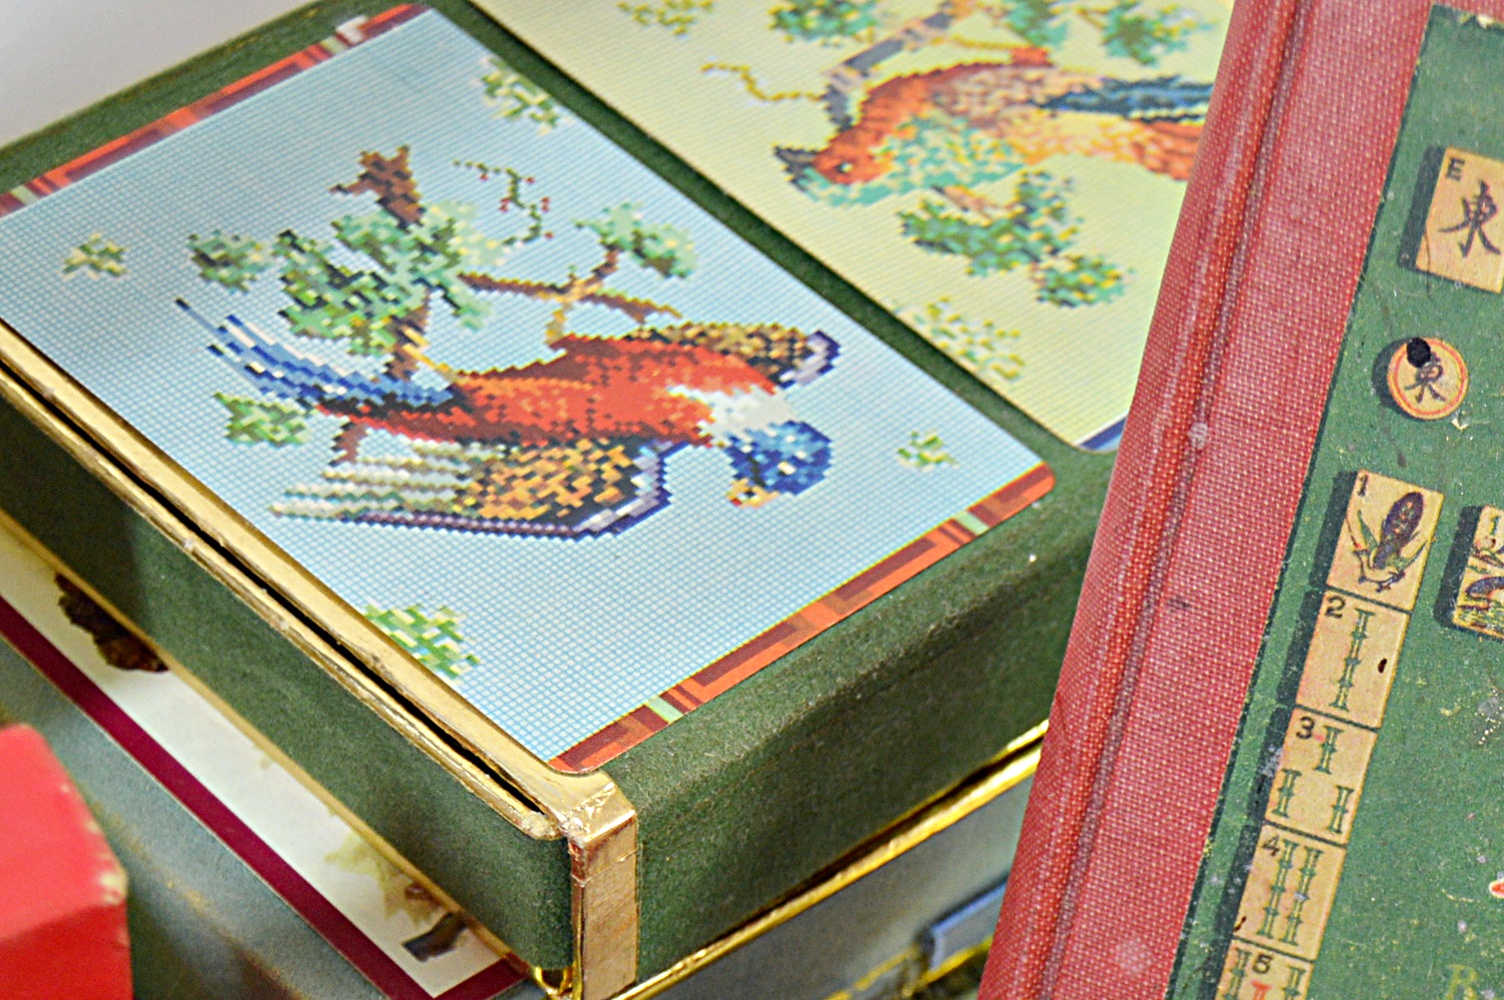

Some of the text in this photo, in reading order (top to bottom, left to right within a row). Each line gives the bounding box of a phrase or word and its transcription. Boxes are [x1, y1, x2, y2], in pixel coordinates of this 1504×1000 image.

[1445, 158, 1466, 181] E
[1439, 179, 1502, 259] 東
[1357, 475, 1368, 497] 1
[1325, 596, 1347, 619] 2
[1296, 716, 1315, 740] 3
[1262, 835, 1281, 857] 4
[1252, 954, 1273, 974] 5
